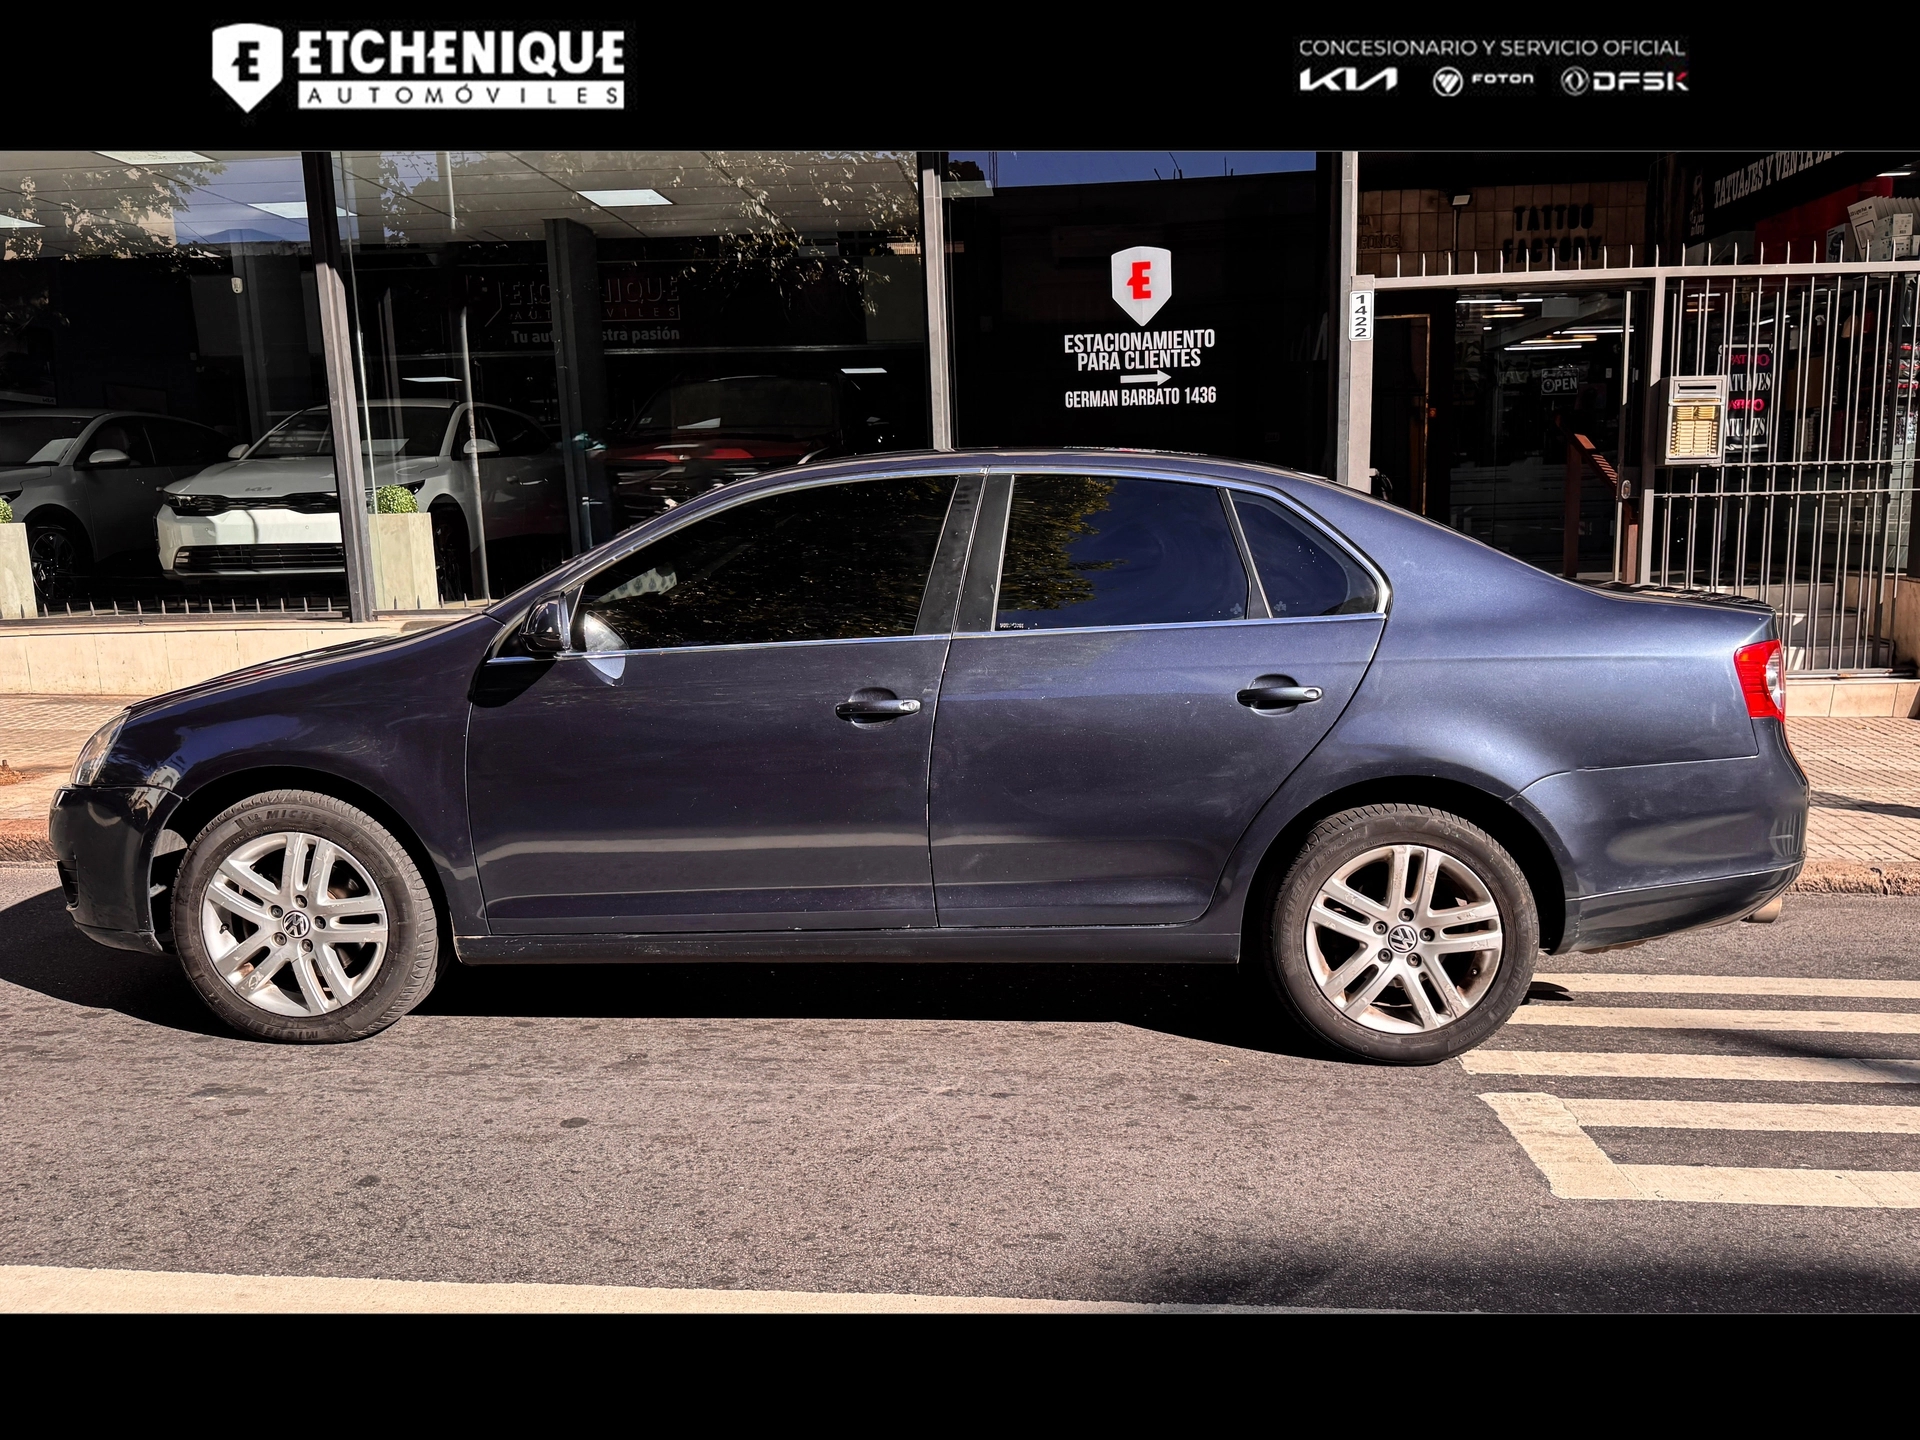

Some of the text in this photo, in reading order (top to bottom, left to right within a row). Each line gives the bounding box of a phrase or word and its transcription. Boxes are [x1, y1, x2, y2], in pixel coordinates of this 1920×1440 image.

[1714, 158, 1764, 209] TATUAJES
[1766, 153, 1776, 187] Y
[1775, 152, 1814, 182] VENTA
[1513, 203, 1595, 231] TATTOO
[1502, 236, 1602, 264] FACTORY
[513, 307, 676, 321] AUTVILES
[1354, 294, 1367, 338] 1422
[511, 326, 680, 344] Tu aut stra pasión
[1065, 329, 1215, 354] ESTACIONAMIENTO
[1078, 349, 1201, 372] PARA CLIENTES
[1065, 386, 1217, 408] GERMAN BARBATO 1436
[1541, 377, 1577, 393] OPEN
